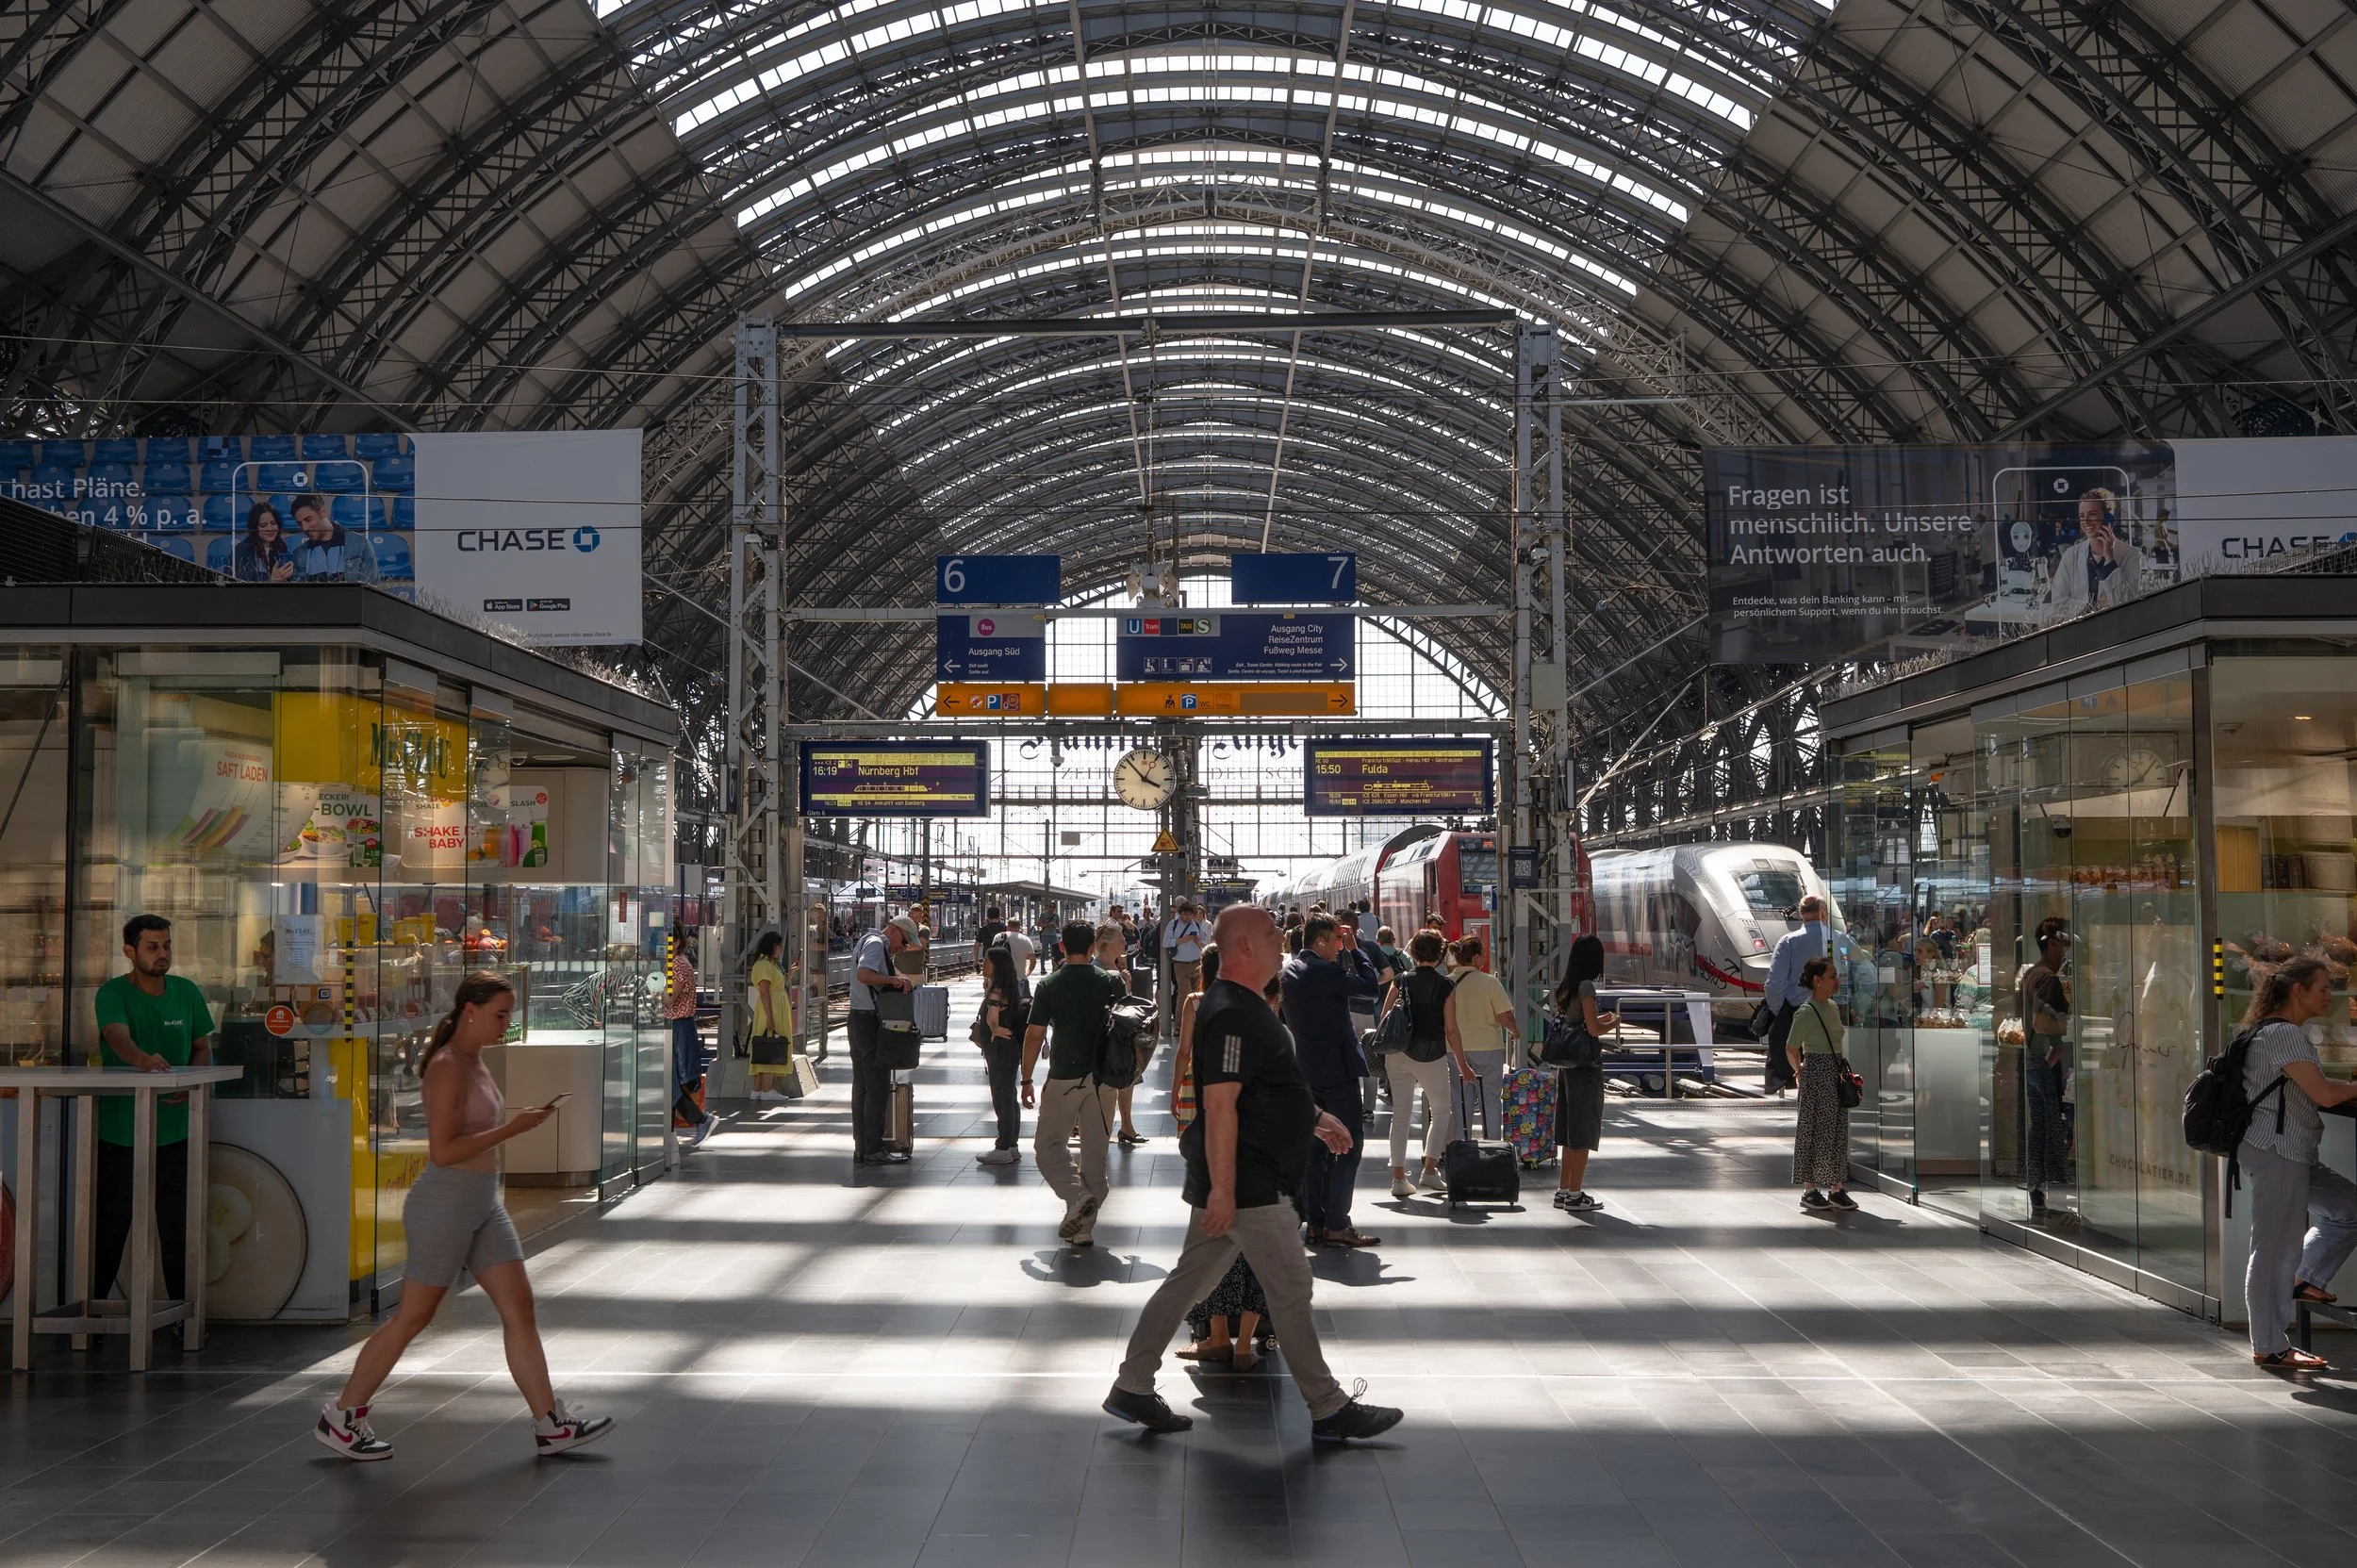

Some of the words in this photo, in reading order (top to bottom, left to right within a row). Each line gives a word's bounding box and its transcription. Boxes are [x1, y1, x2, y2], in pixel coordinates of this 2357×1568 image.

[11, 478, 64, 499] hast
[74, 477, 146, 499] Pläne.
[1728, 486, 1811, 510] Fragen
[1820, 484, 1850, 504] ist
[104, 505, 119, 525] 4
[126, 505, 147, 525] %
[157, 508, 178, 530] p.
[187, 508, 207, 524] a.
[1730, 512, 1875, 535] menschlich.
[1885, 513, 1972, 533] Unsere
[457, 529, 566, 552] CHASE
[1730, 544, 1863, 565] Antworten
[1871, 543, 1932, 563] auch.
[944, 559, 965, 593] 6
[1327, 556, 1349, 590] 7
[1733, 597, 1777, 605] Entdecke,
[1800, 596, 1821, 604] dein
[1822, 596, 1859, 605] Banking
[1862, 595, 1885, 603] kann
[1893, 595, 1908, 603] mit
[1734, 608, 1796, 619] persönlichem
[1799, 607, 1838, 618] Support,
[1869, 606, 1881, 615] du
[1883, 606, 1898, 615] ihn
[1901, 605, 1944, 615] brauchst.
[1129, 619, 1139, 634] U
[1197, 619, 1210, 634] S
[1271, 625, 1306, 635] Ausgang
[1308, 624, 1323, 635] City
[968, 648, 1002, 657] Ausgang
[1263, 646, 1294, 655] Fußweg
[1296, 646, 1323, 654] Messe
[986, 695, 997, 709] P
[217, 760, 239, 779] SAFT
[240, 765, 269, 783] LADEN
[813, 767, 837, 776] 16:19
[858, 766, 899, 777] Nürnberg
[903, 767, 919, 776] Hbf
[1211, 767, 1302, 779] DEUTSCH
[1315, 765, 1341, 774] 15:50
[1362, 764, 1388, 774] Fulda
[318, 793, 349, 801] ECKER!
[415, 826, 460, 837] SHAKE
[429, 838, 465, 849] BABY
